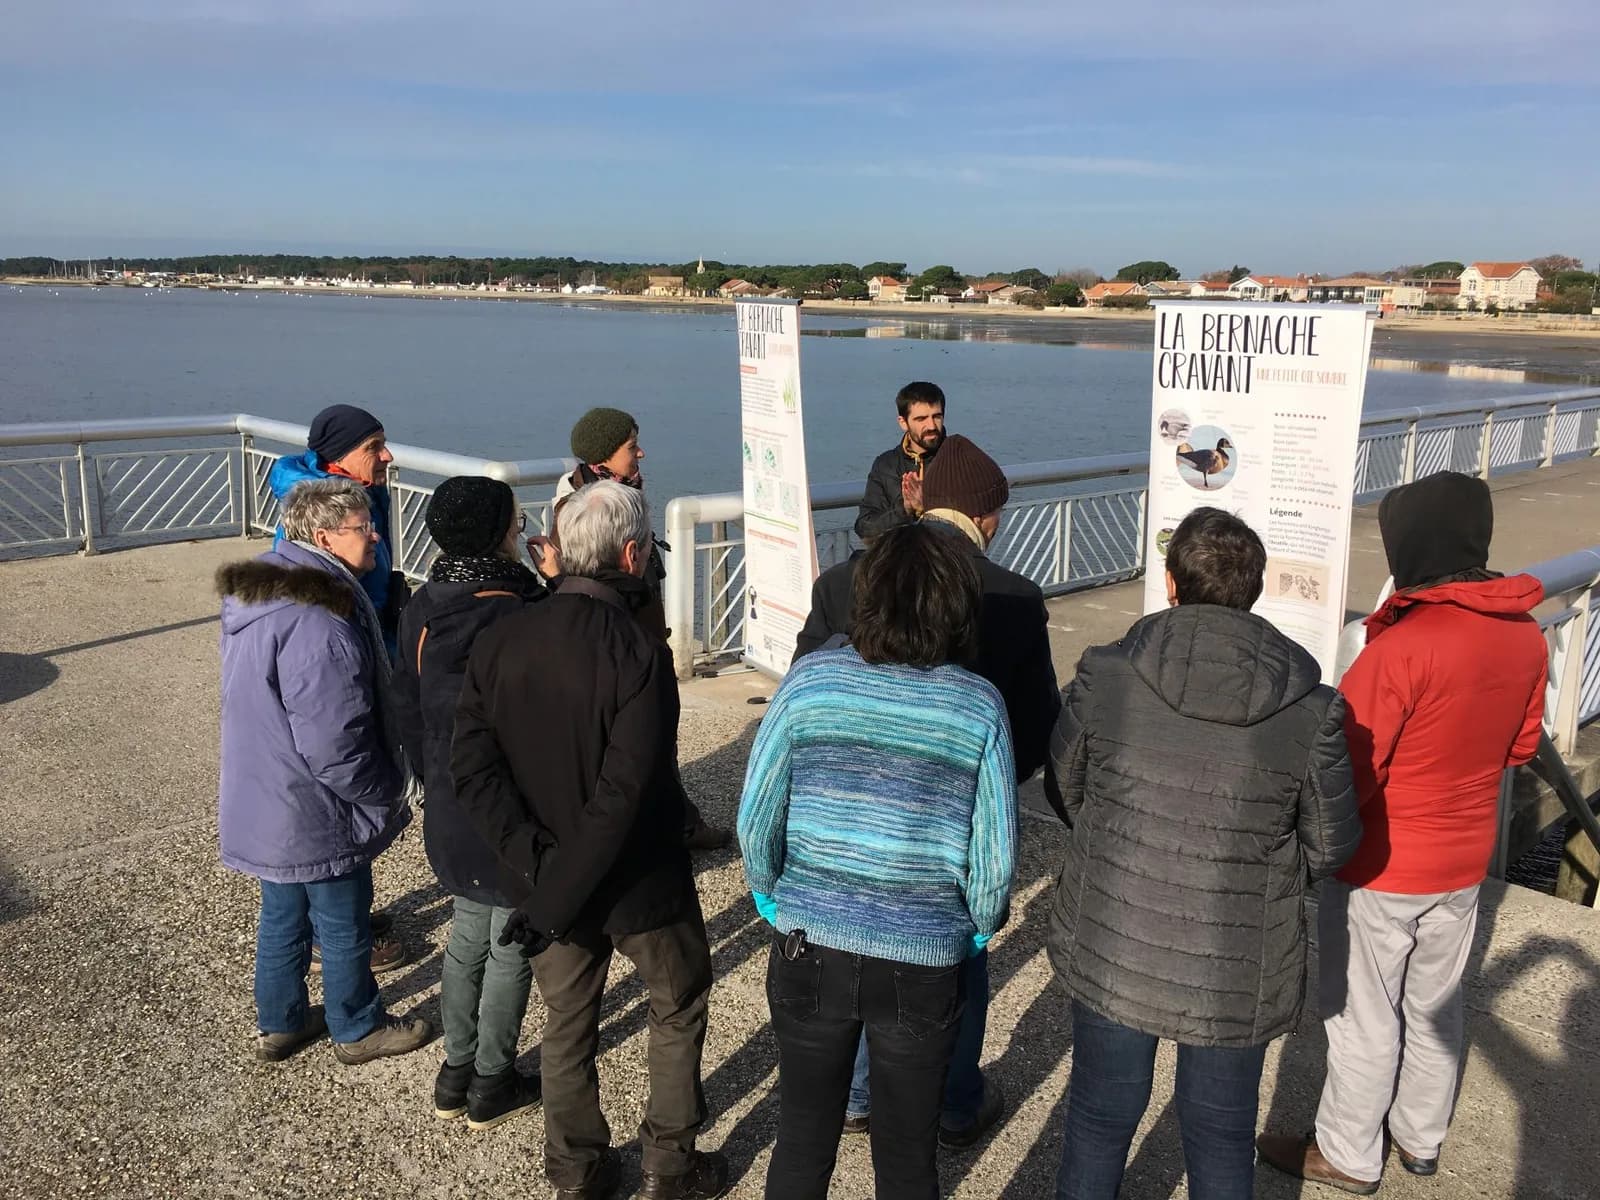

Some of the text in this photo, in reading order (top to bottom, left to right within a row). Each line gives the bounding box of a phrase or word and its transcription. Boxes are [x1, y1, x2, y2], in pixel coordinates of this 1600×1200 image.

[740, 331, 766, 360] RAVANT
[1160, 312, 1322, 356] LA BERNACHE
[1158, 352, 1256, 394] CRAVANT
[1272, 368, 1298, 383] PETITE
[1269, 507, 1303, 518] Légende
